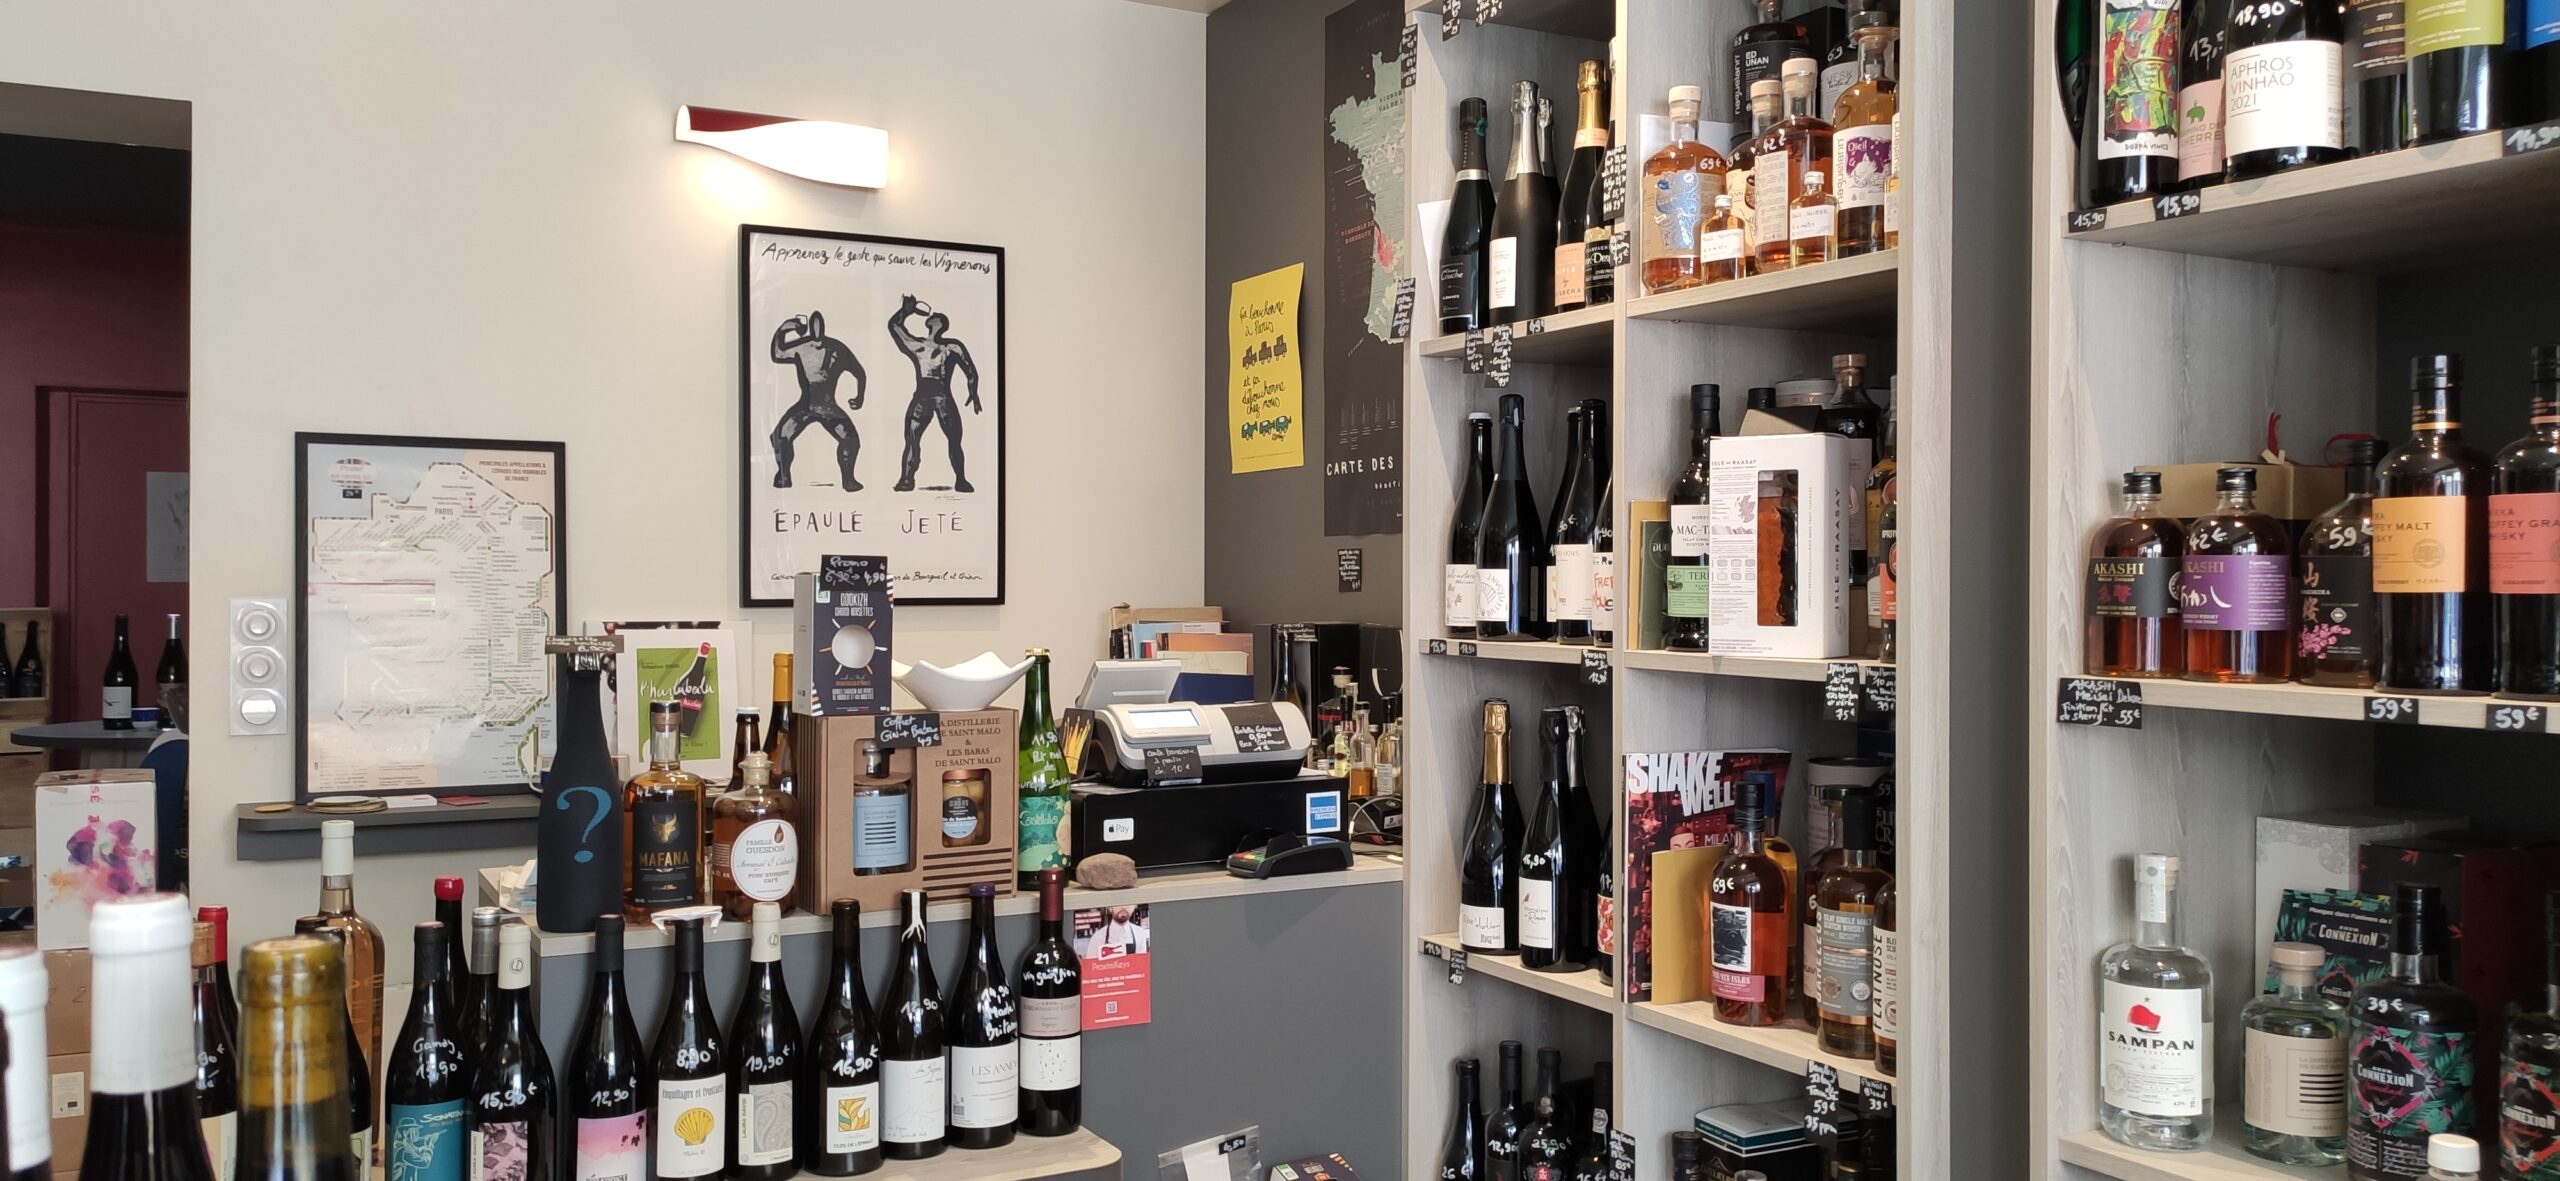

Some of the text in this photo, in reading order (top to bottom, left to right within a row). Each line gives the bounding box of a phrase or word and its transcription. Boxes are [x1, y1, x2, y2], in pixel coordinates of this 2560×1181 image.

[1745, 56, 1770, 67] UNAN
[1827, 46, 1843, 62] 69
[2230, 56, 2294, 80] APHROS
[2230, 71, 2295, 95] VINHÃO
[2230, 93, 2257, 111] 2021
[1699, 157, 1722, 170] 69€
[2156, 194, 2200, 216] 15,90
[2073, 211, 2105, 228] 15,90
[762, 242, 991, 274] Apprenez le geste qui sauve les Vignerons
[1243, 375, 1251, 387] et
[1326, 455, 1394, 477] CARTE DES
[1732, 458, 1757, 466] RAASAY
[434, 507, 454, 516] PARIS
[901, 509, 965, 534] JETÉ
[2396, 521, 2432, 531] MALT
[2528, 518, 2560, 530] GRA
[1676, 525, 1710, 536] MAC-T
[2189, 526, 2228, 551] 42€
[1833, 487, 1841, 610] ISLE RAASAY
[830, 556, 869, 568] Promo
[2094, 562, 2145, 576] AKASHI
[840, 592, 868, 607] COOKIZH
[2067, 679, 2117, 692] AKASHI
[1835, 708, 1856, 720] 75€
[1877, 701, 1895, 712] 79€
[2060, 702, 2098, 714] Finition
[2369, 698, 2413, 721] 59€
[882, 715, 916, 730] Coffret
[948, 717, 1001, 727] DISTILLERIE
[2114, 708, 2141, 725] 55€
[2495, 707, 2540, 730] 59€
[949, 727, 1001, 737] SAINT MALO
[947, 747, 990, 757] LES BABAS
[935, 756, 1001, 768] DE SAINT MALO
[1171, 765, 1182, 774] 10
[1627, 752, 1723, 794] SHAKE
[1877, 783, 1891, 796] 59
[1679, 780, 1735, 817] WELL
[1876, 807, 1897, 826] ELI
[1115, 823, 1130, 834] Pay
[745, 845, 785, 854] GUESDON
[639, 851, 689, 867] MAFANA
[1712, 877, 1735, 894] 69€
[2319, 923, 2379, 947] CONNEXION
[1022, 970, 1035, 982] vin
[2367, 996, 2404, 1014] 39€
[2108, 1030, 2196, 1051] SAMPAN
[676, 1038, 716, 1070] 8,90€
[745, 1044, 790, 1073] 19,90€
[833, 1044, 879, 1079] 16,90€
[971, 1063, 991, 1077] LES
[2357, 1063, 2414, 1088] CONNEXION
[480, 1081, 538, 1111] 15,90€
[590, 1075, 637, 1108] 12,90€
[1813, 1100, 1836, 1114] 59€
[1869, 1099, 1888, 1110] 39€
[2502, 1101, 2556, 1130] CONNEXION
[1441, 1166, 1455, 1180] 26
